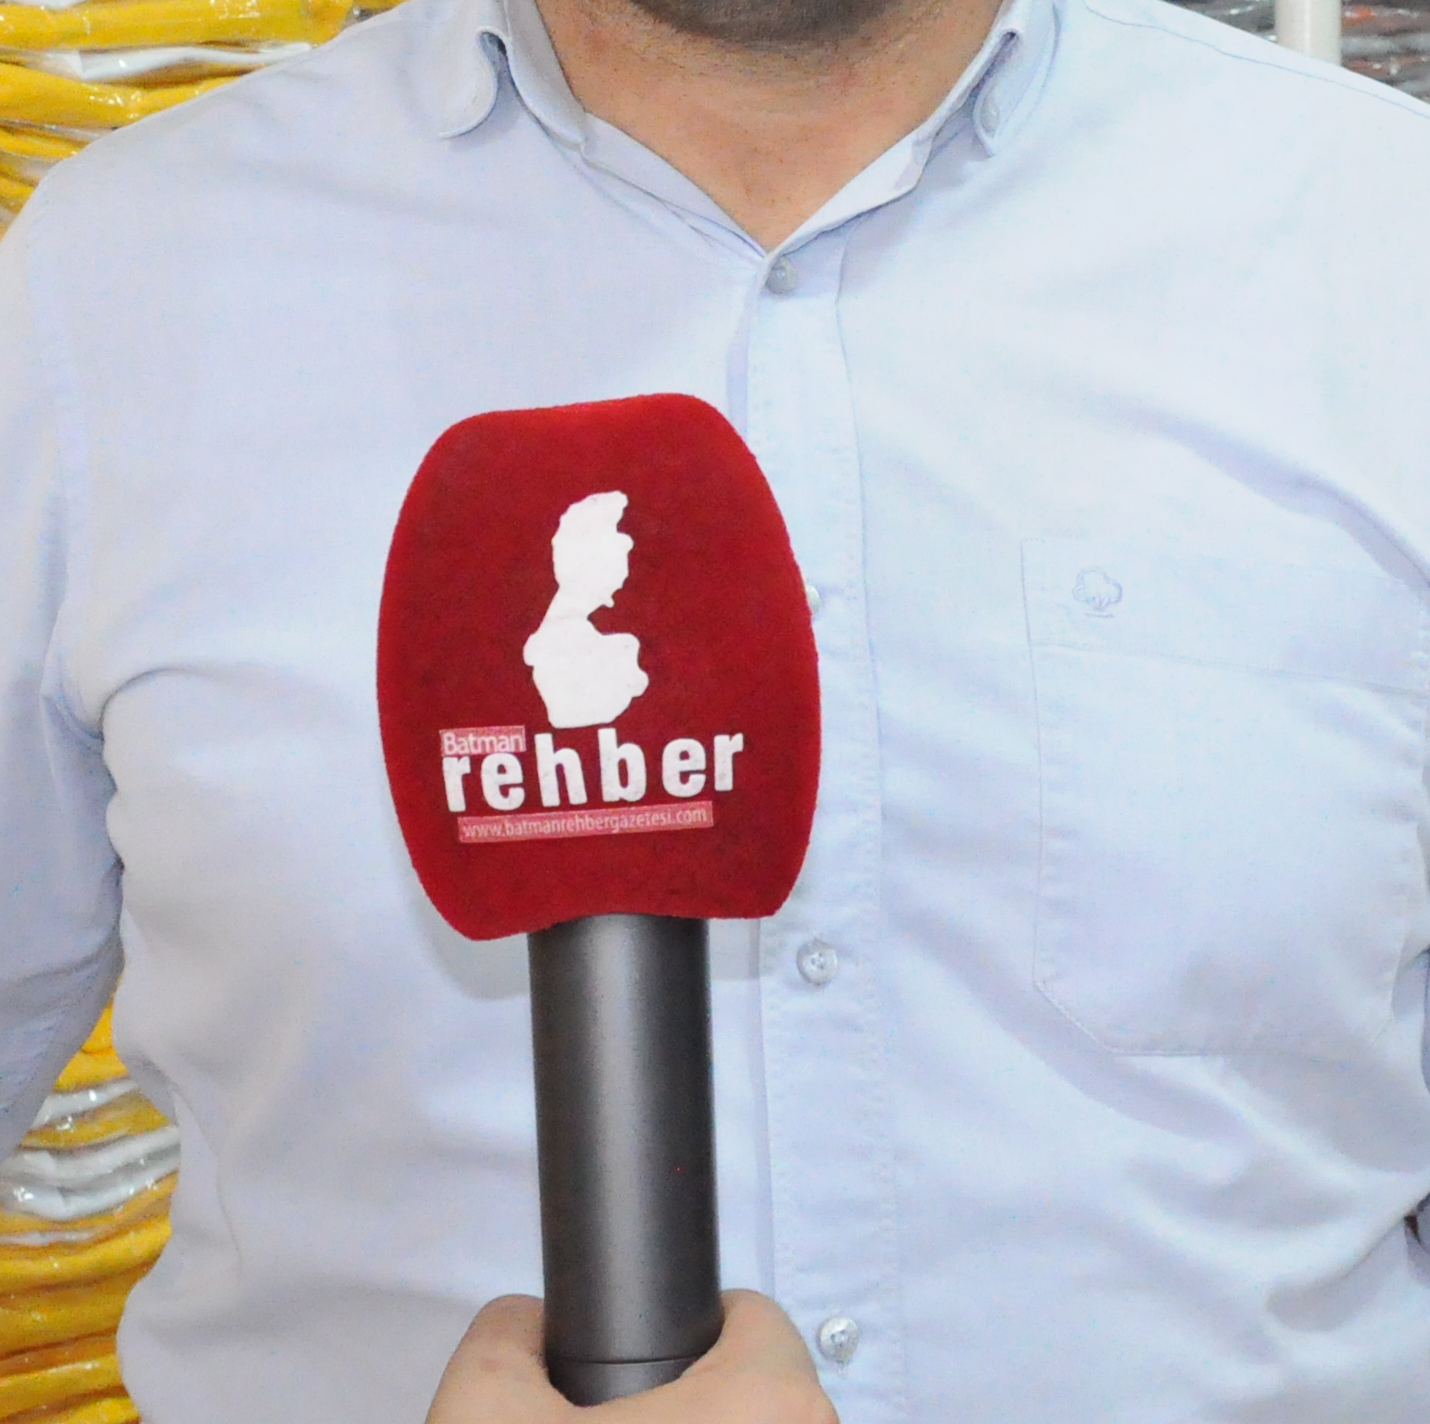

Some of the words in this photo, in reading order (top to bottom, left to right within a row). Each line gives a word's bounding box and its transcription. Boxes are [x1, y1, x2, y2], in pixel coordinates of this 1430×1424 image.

[442, 731, 524, 756] Batman
[441, 727, 744, 812] rehber
[461, 808, 708, 838] www.batmanrehbergazetesi.com
